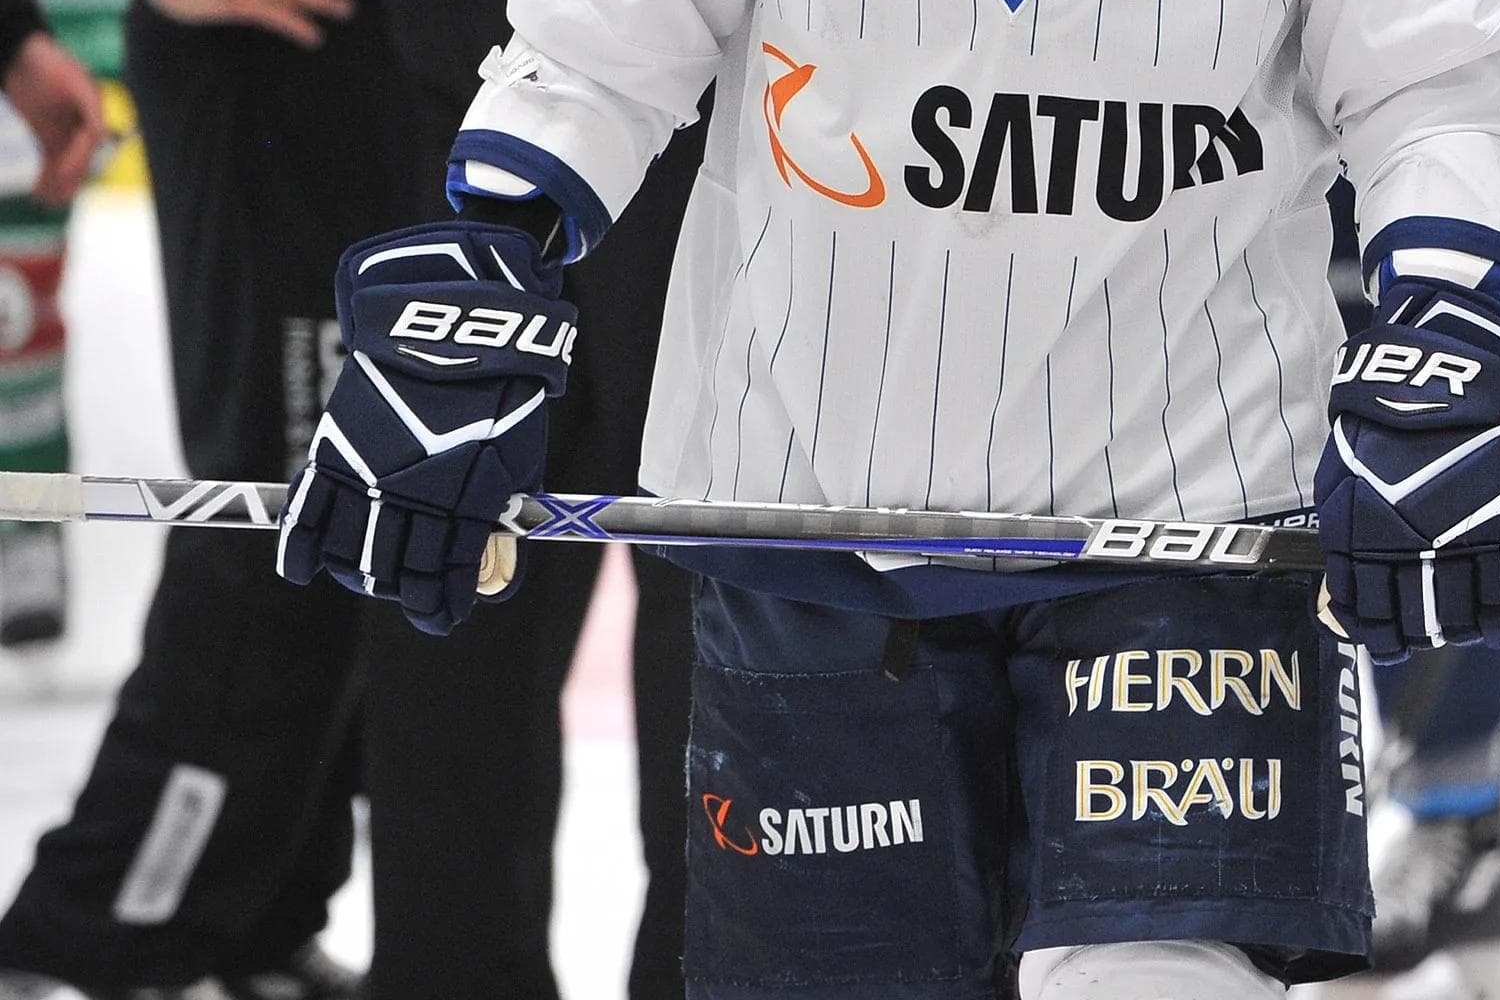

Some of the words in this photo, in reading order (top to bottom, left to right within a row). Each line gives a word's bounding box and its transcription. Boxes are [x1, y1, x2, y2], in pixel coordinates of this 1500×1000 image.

[904, 84, 1265, 222] SATURN
[1064, 648, 1302, 717] HERRN
[1075, 757, 1282, 826] BRÄU
[759, 799, 924, 857] SATURN
